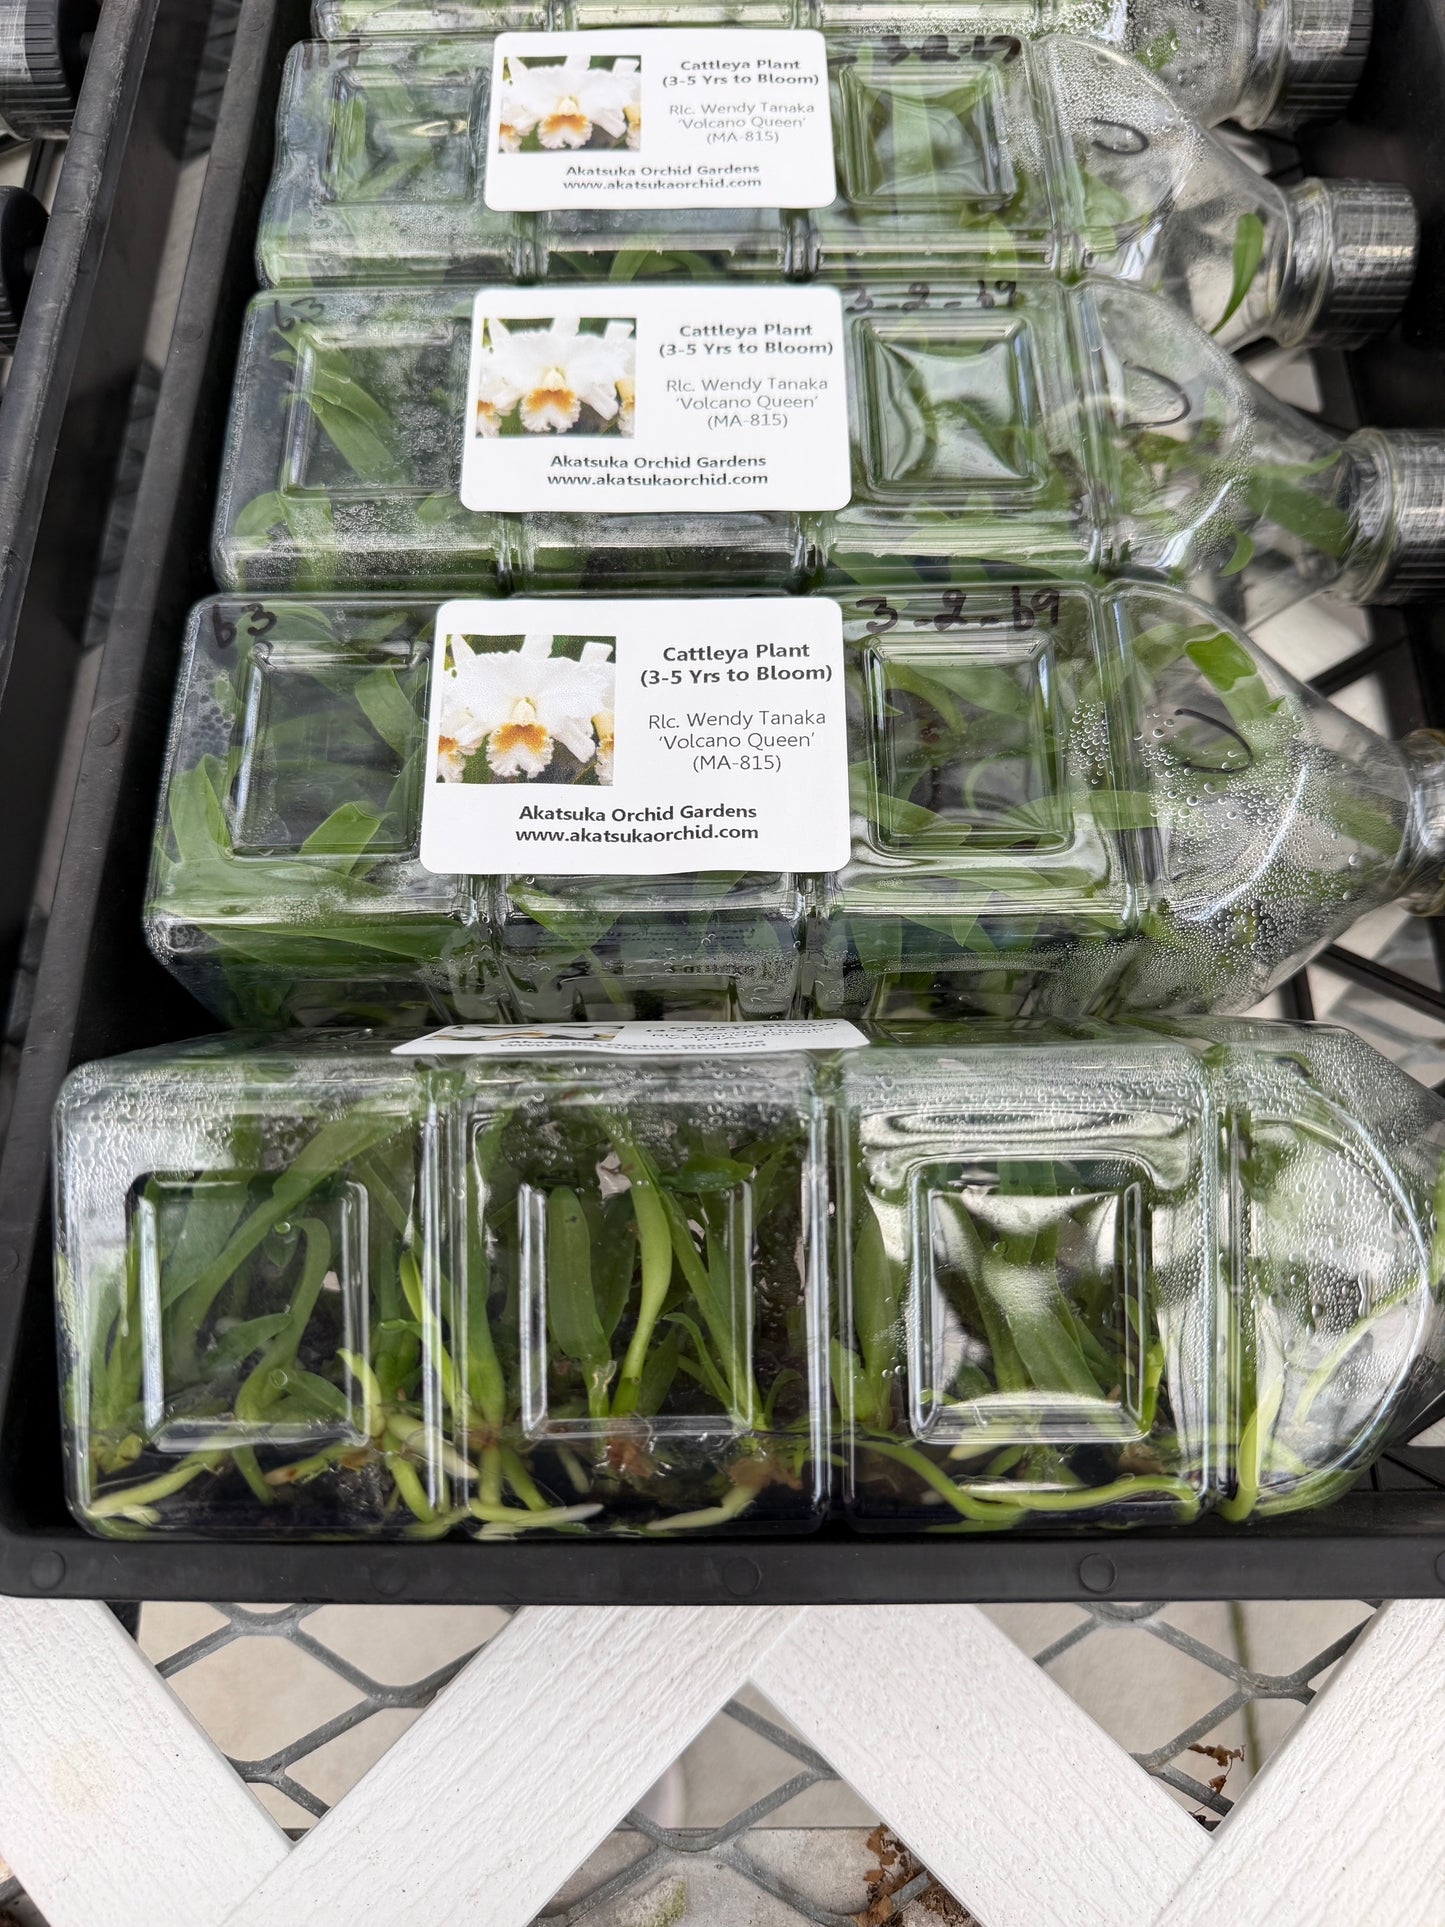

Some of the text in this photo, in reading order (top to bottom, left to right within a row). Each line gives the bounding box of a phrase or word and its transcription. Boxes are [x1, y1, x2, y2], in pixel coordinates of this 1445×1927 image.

[680, 58, 801, 73] Cattleya Plant
[662, 72, 820, 89] (3-5 Yrs to Bloom)
[669, 101, 815, 116] Rlc. Wendy Tanaka
[706, 130, 780, 145] (MA-815)
[566, 163, 760, 177] Akatsuka Orchid Gardens
[562, 177, 762, 190] www.akatsukaorchid.com
[679, 322, 813, 340] Cattleya Plant
[658, 340, 834, 359] (3-5 Yrs to Bloom)
[666, 376, 828, 394] Rlc. Wendy Tanaka
[707, 413, 788, 431] (MA-815)
[550, 454, 767, 469] Akatsuka Orchid Gardens
[546, 472, 768, 486] www.akatsukaorchid.com
[662, 642, 811, 665] Cattleya Plant
[640, 664, 833, 689] (3-5 Yrs to Bloom)
[648, 708, 826, 731] Rlc. Wendy Tanaka
[658, 731, 815, 752] 'Volcano Queen'
[692, 754, 782, 774] (MA-815)
[518, 802, 758, 823] Akatsuka Orchid Gardens
[515, 824, 759, 844] www.akatsukaorchid.com
